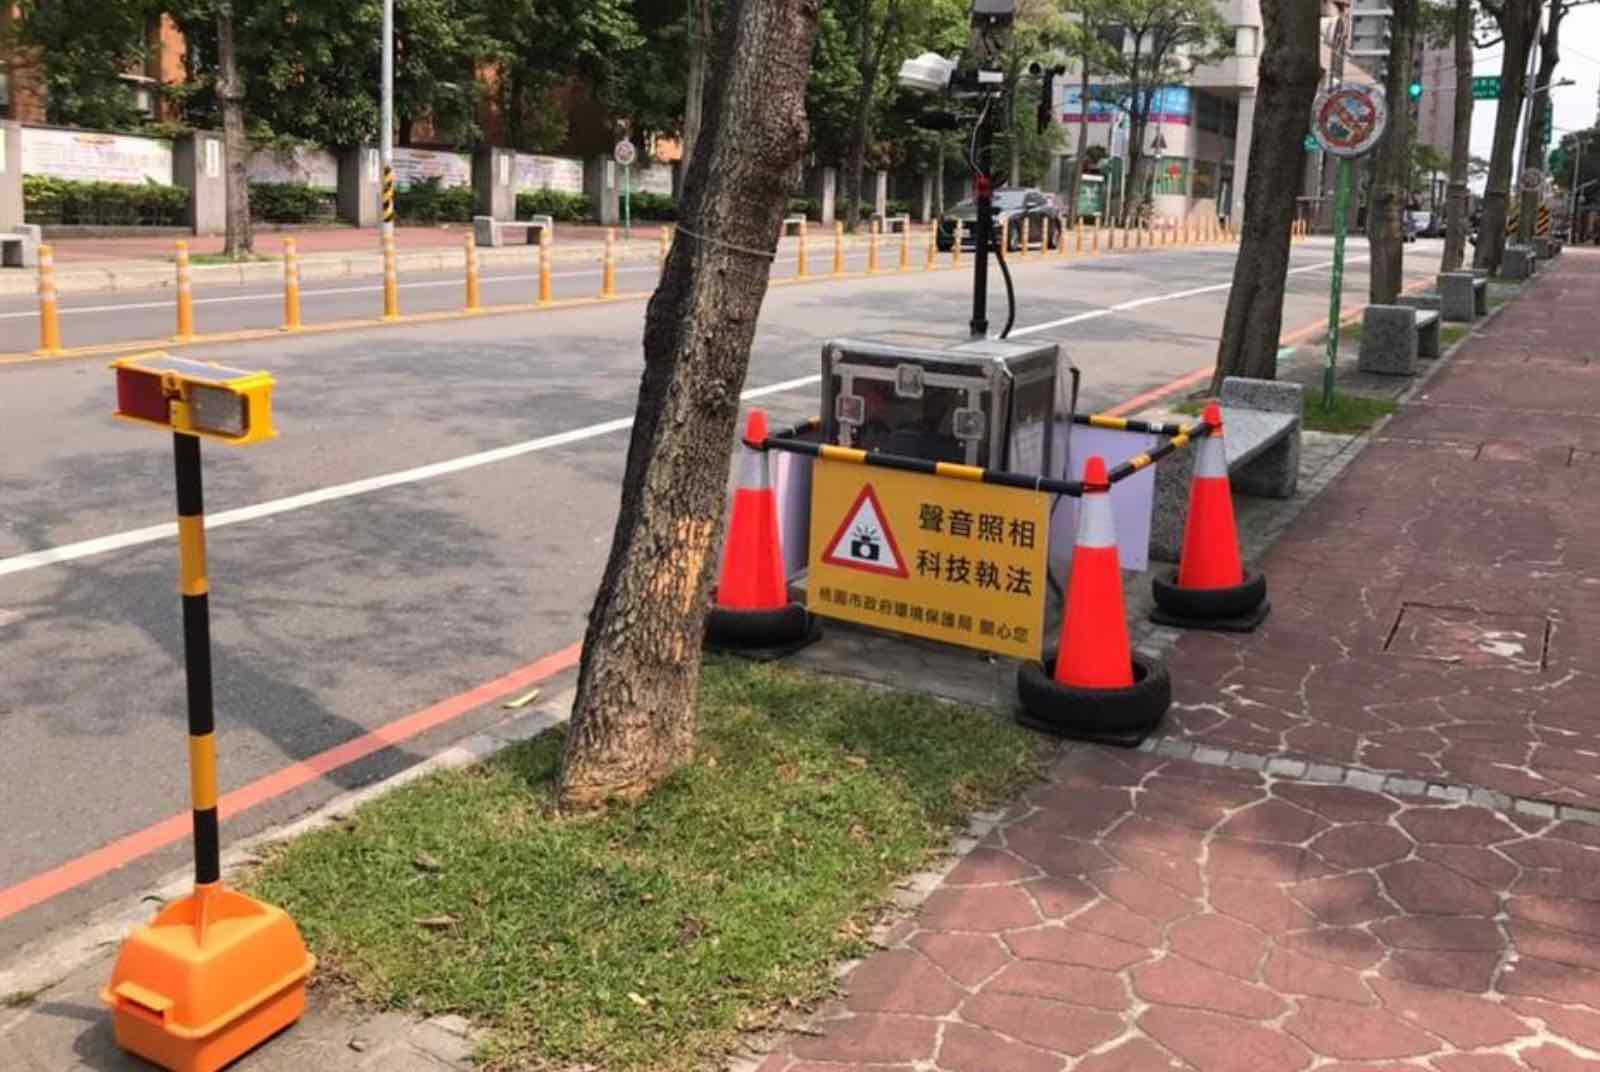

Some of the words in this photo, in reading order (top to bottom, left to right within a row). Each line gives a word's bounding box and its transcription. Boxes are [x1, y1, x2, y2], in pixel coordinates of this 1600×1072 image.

[919, 503, 1036, 549] 聲音照相
[916, 549, 1033, 597] 科技執法
[818, 587, 974, 633] 桃園市政府環境保護局
